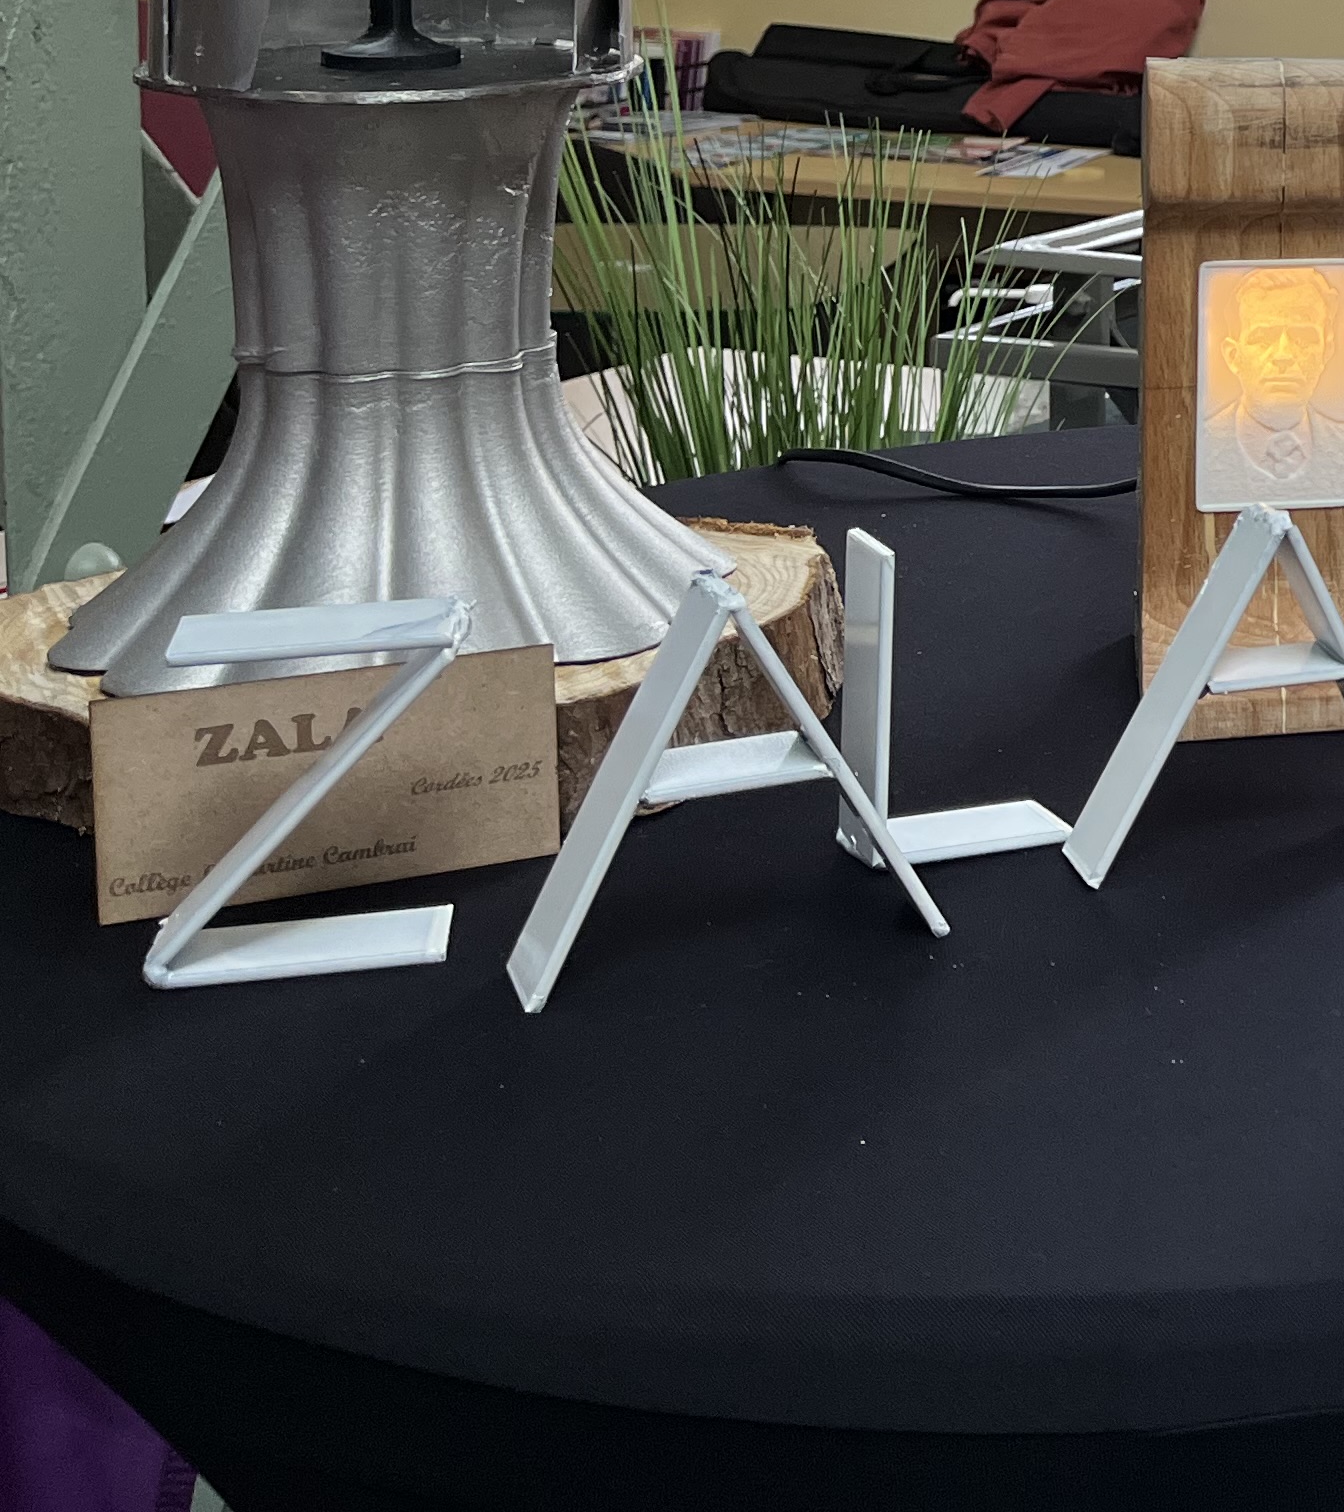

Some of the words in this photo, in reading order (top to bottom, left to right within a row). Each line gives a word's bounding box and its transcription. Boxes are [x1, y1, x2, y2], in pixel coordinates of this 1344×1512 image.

[410, 772, 483, 796] Cordées
[488, 759, 543, 785] 2025
[108, 871, 192, 898] Collège
[322, 835, 418, 866] Cambrai
